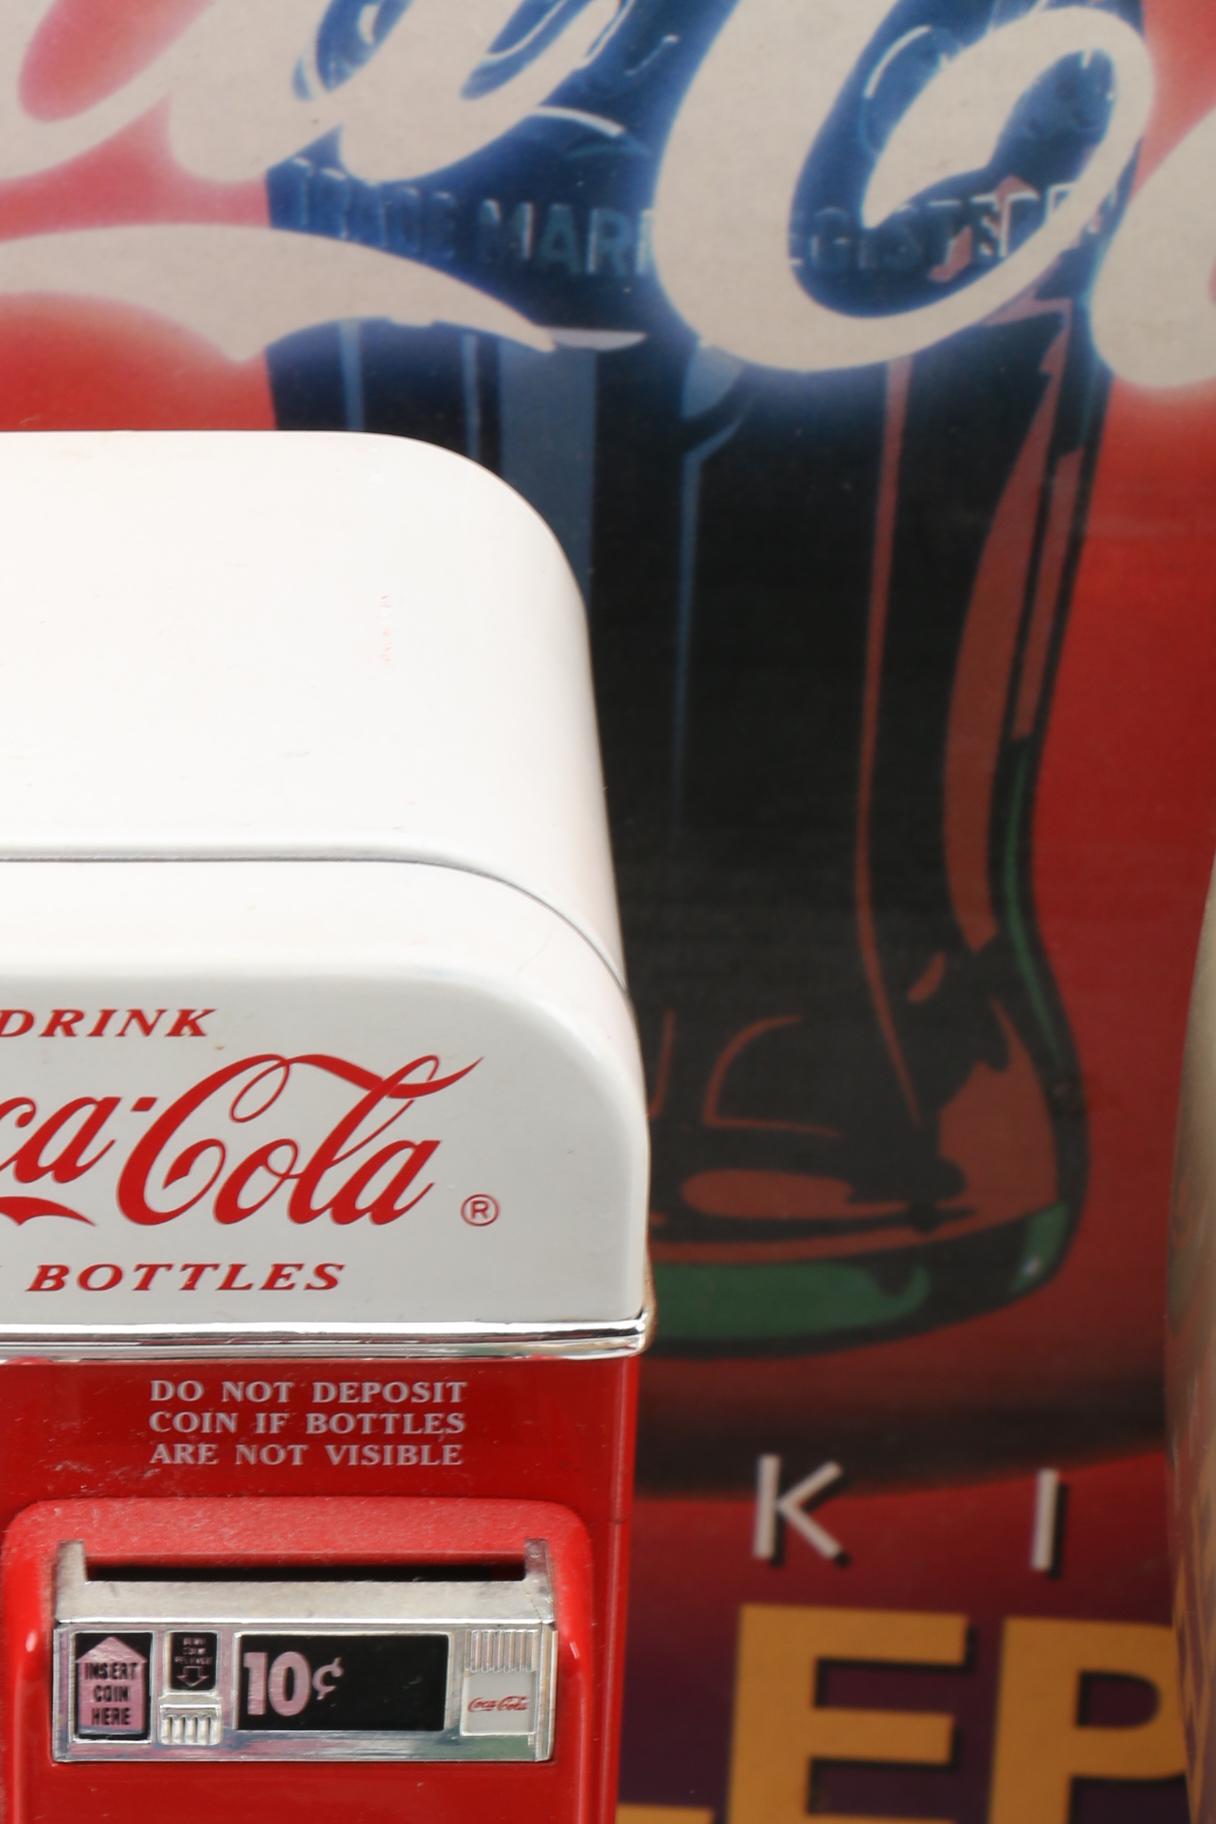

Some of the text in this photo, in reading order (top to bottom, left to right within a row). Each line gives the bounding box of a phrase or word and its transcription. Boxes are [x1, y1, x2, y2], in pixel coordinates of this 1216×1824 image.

[25, 1262, 346, 1292] BOTTLES
[149, 1380, 468, 1404] DO NOT DEPOSIT
[148, 1411, 466, 1435] COIN IF BOTTLES
[149, 1443, 463, 1466] ARE NOT VISIBLE
[86, 1662, 139, 1680] INSERT
[94, 1685, 129, 1702] COIN
[91, 1708, 131, 1725] HERE
